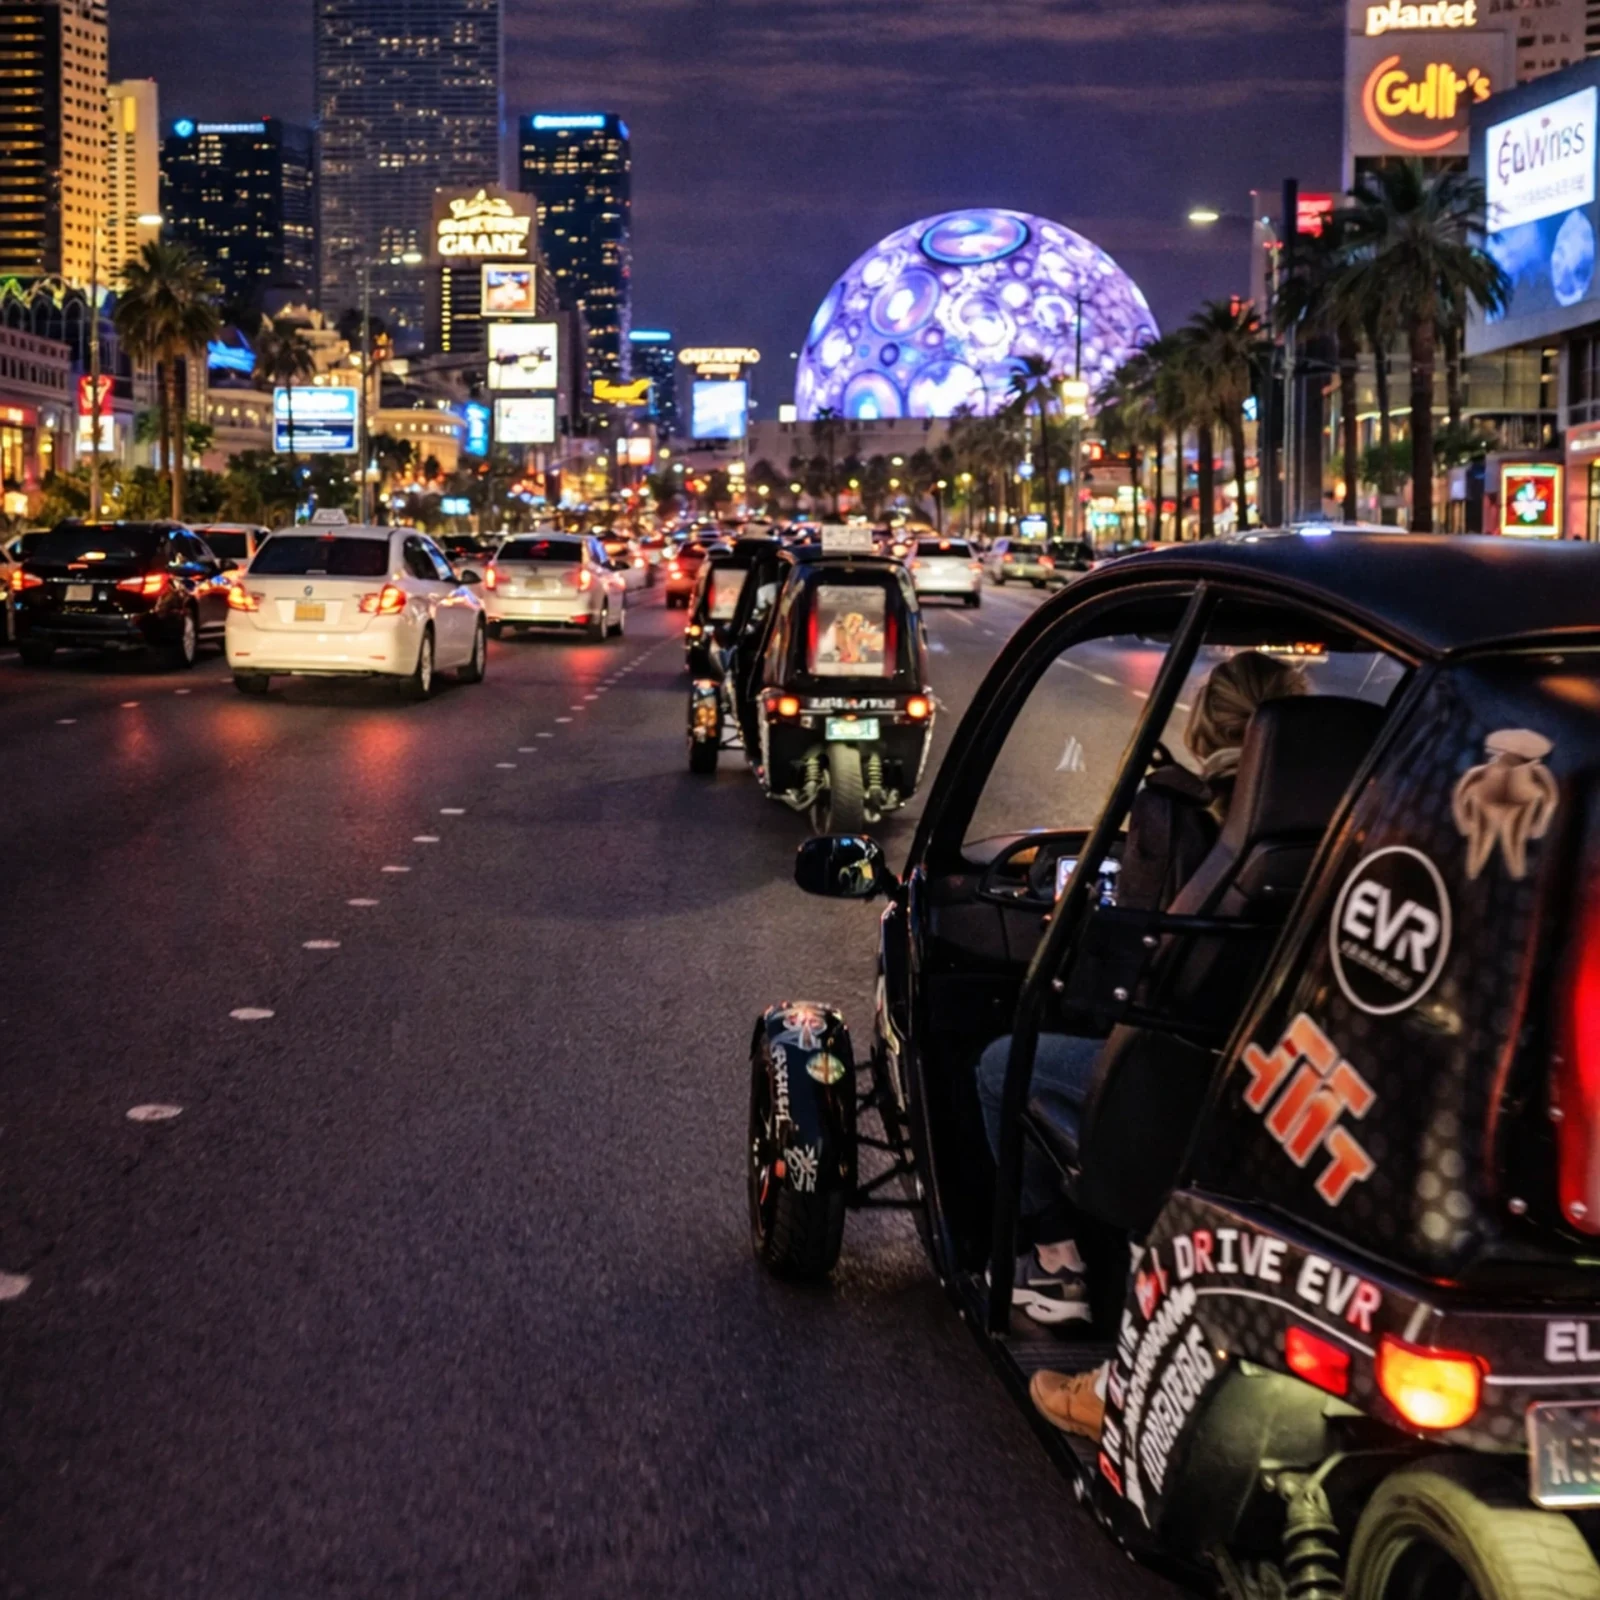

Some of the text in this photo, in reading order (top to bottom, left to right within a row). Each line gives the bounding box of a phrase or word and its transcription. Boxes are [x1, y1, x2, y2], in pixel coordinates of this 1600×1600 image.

[1342, 880, 1440, 973] EVR
[1172, 1228, 1288, 1284] DRIVE
[1295, 1253, 1383, 1333] EVR
